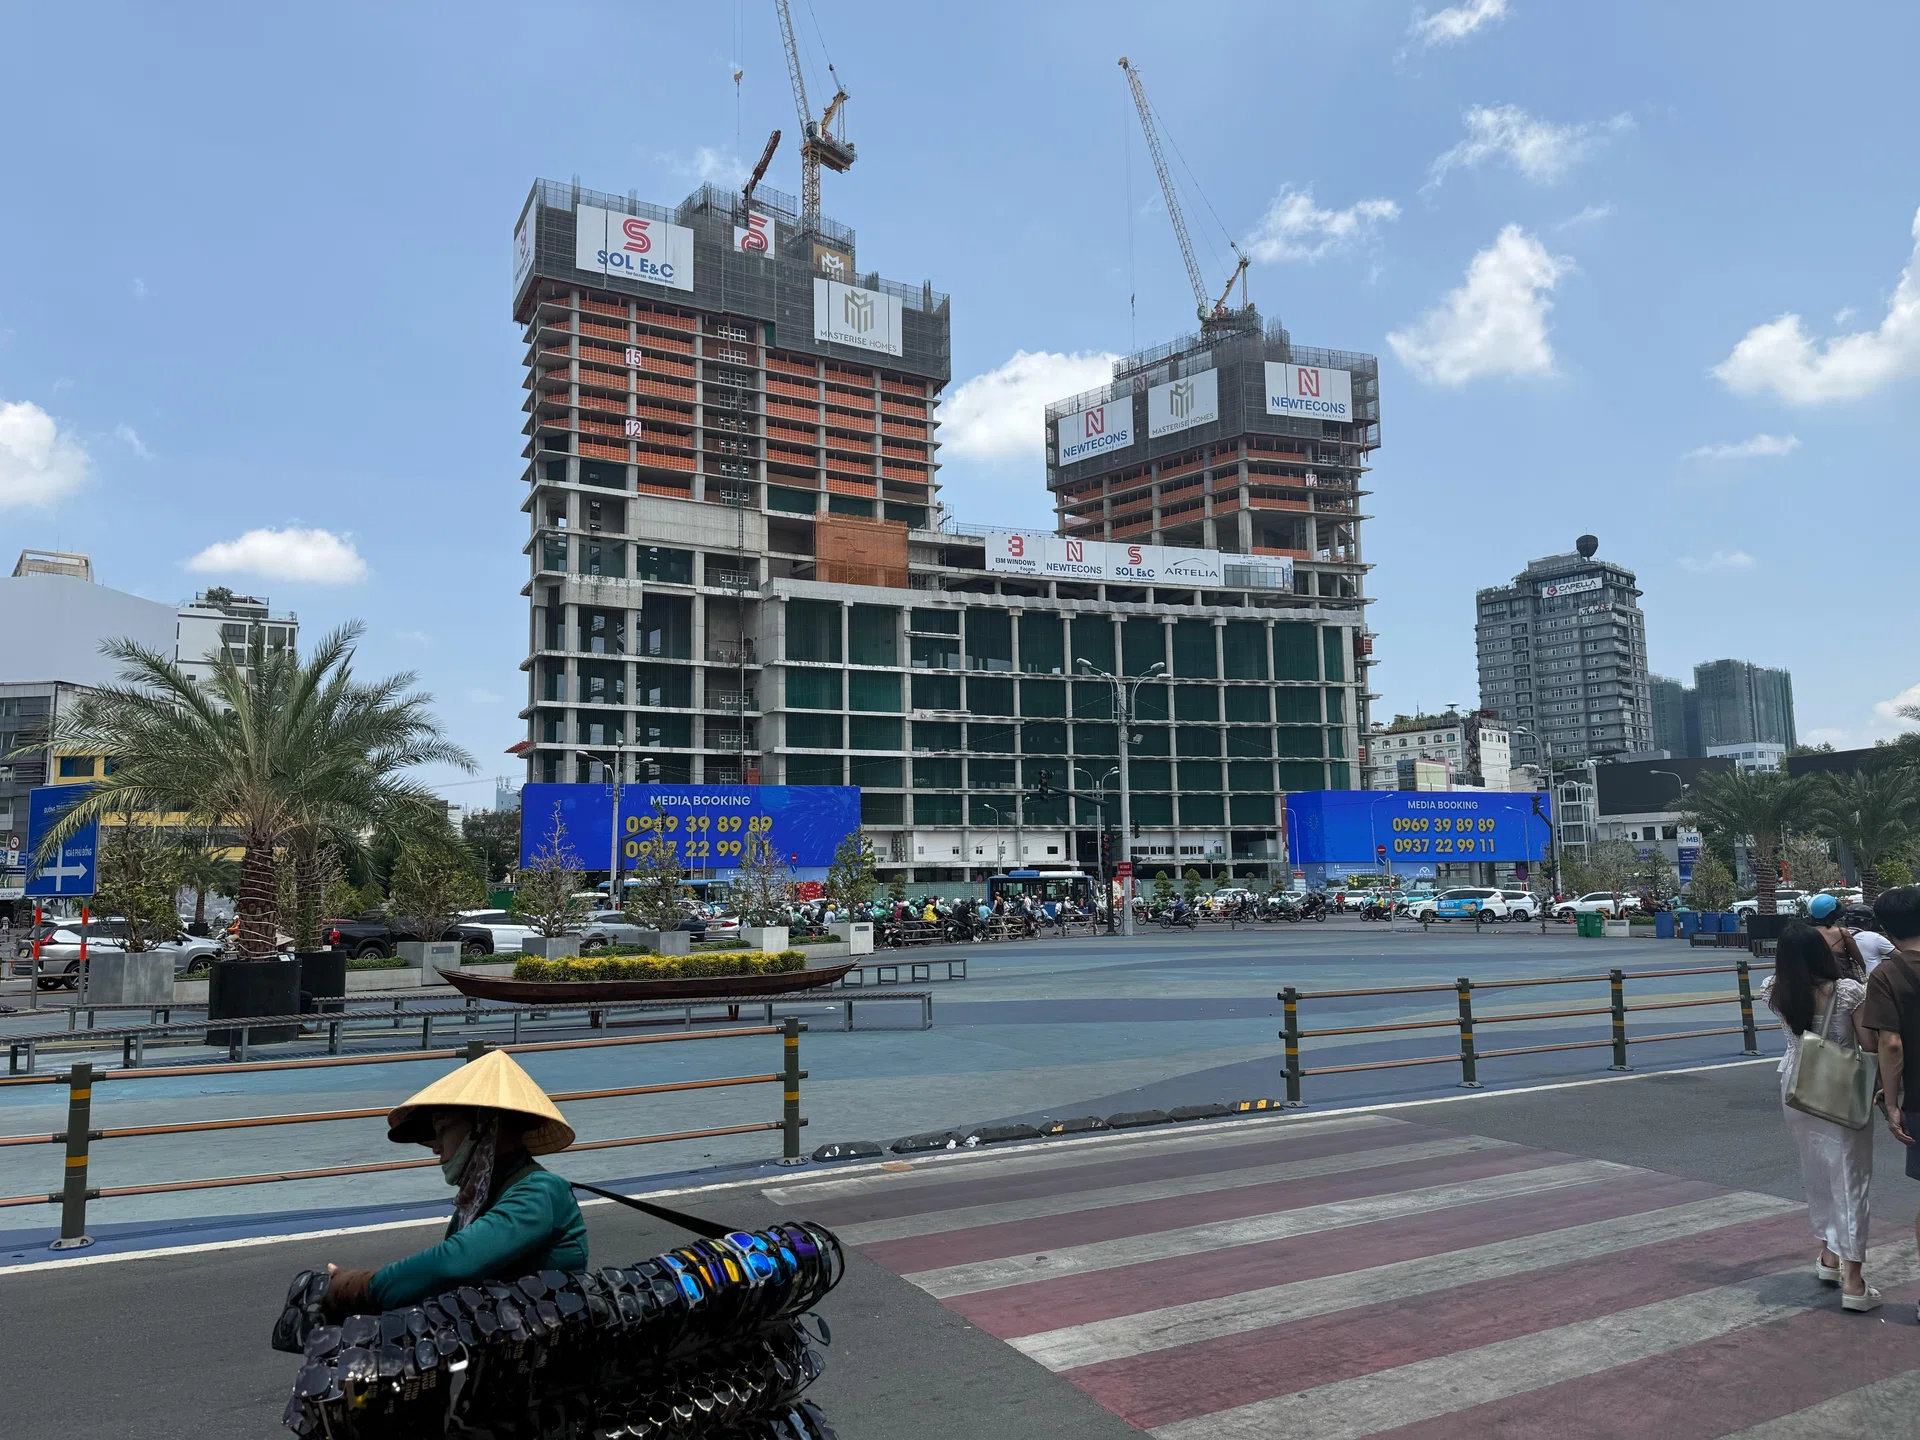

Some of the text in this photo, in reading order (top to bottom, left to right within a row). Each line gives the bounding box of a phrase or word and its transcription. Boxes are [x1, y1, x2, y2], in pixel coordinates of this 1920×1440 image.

[597, 250, 674, 278] SOL E&C
[820, 330, 897, 353] MASTERISE HOMES
[626, 349, 641, 364] 15
[1271, 396, 1346, 414] NEWTECONS
[626, 420, 641, 436] 12
[1152, 412, 1214, 435] MASTERISE HOMES
[1063, 429, 1128, 458] NEWTECONS
[1306, 475, 1317, 487] 12
[1006, 558, 1036, 566] WINDOWS
[1046, 562, 1102, 574] NEWTECONS
[1115, 567, 1155, 577] SOL E&C
[1164, 567, 1219, 578] ARTELIA
[1559, 580, 1596, 592] CAPELLA
[650, 795, 751, 806] MEDIA BOOKING
[1407, 800, 1478, 810] MEDIA BOOKING
[685, 815, 711, 833] 39
[717, 815, 742, 833] 89
[748, 815, 773, 833] 89
[1392, 817, 1496, 832] 0969 39 89 89
[685, 841, 710, 857] 22
[716, 841, 742, 857] 99
[1394, 838, 1495, 853] 0937 22 99 11
